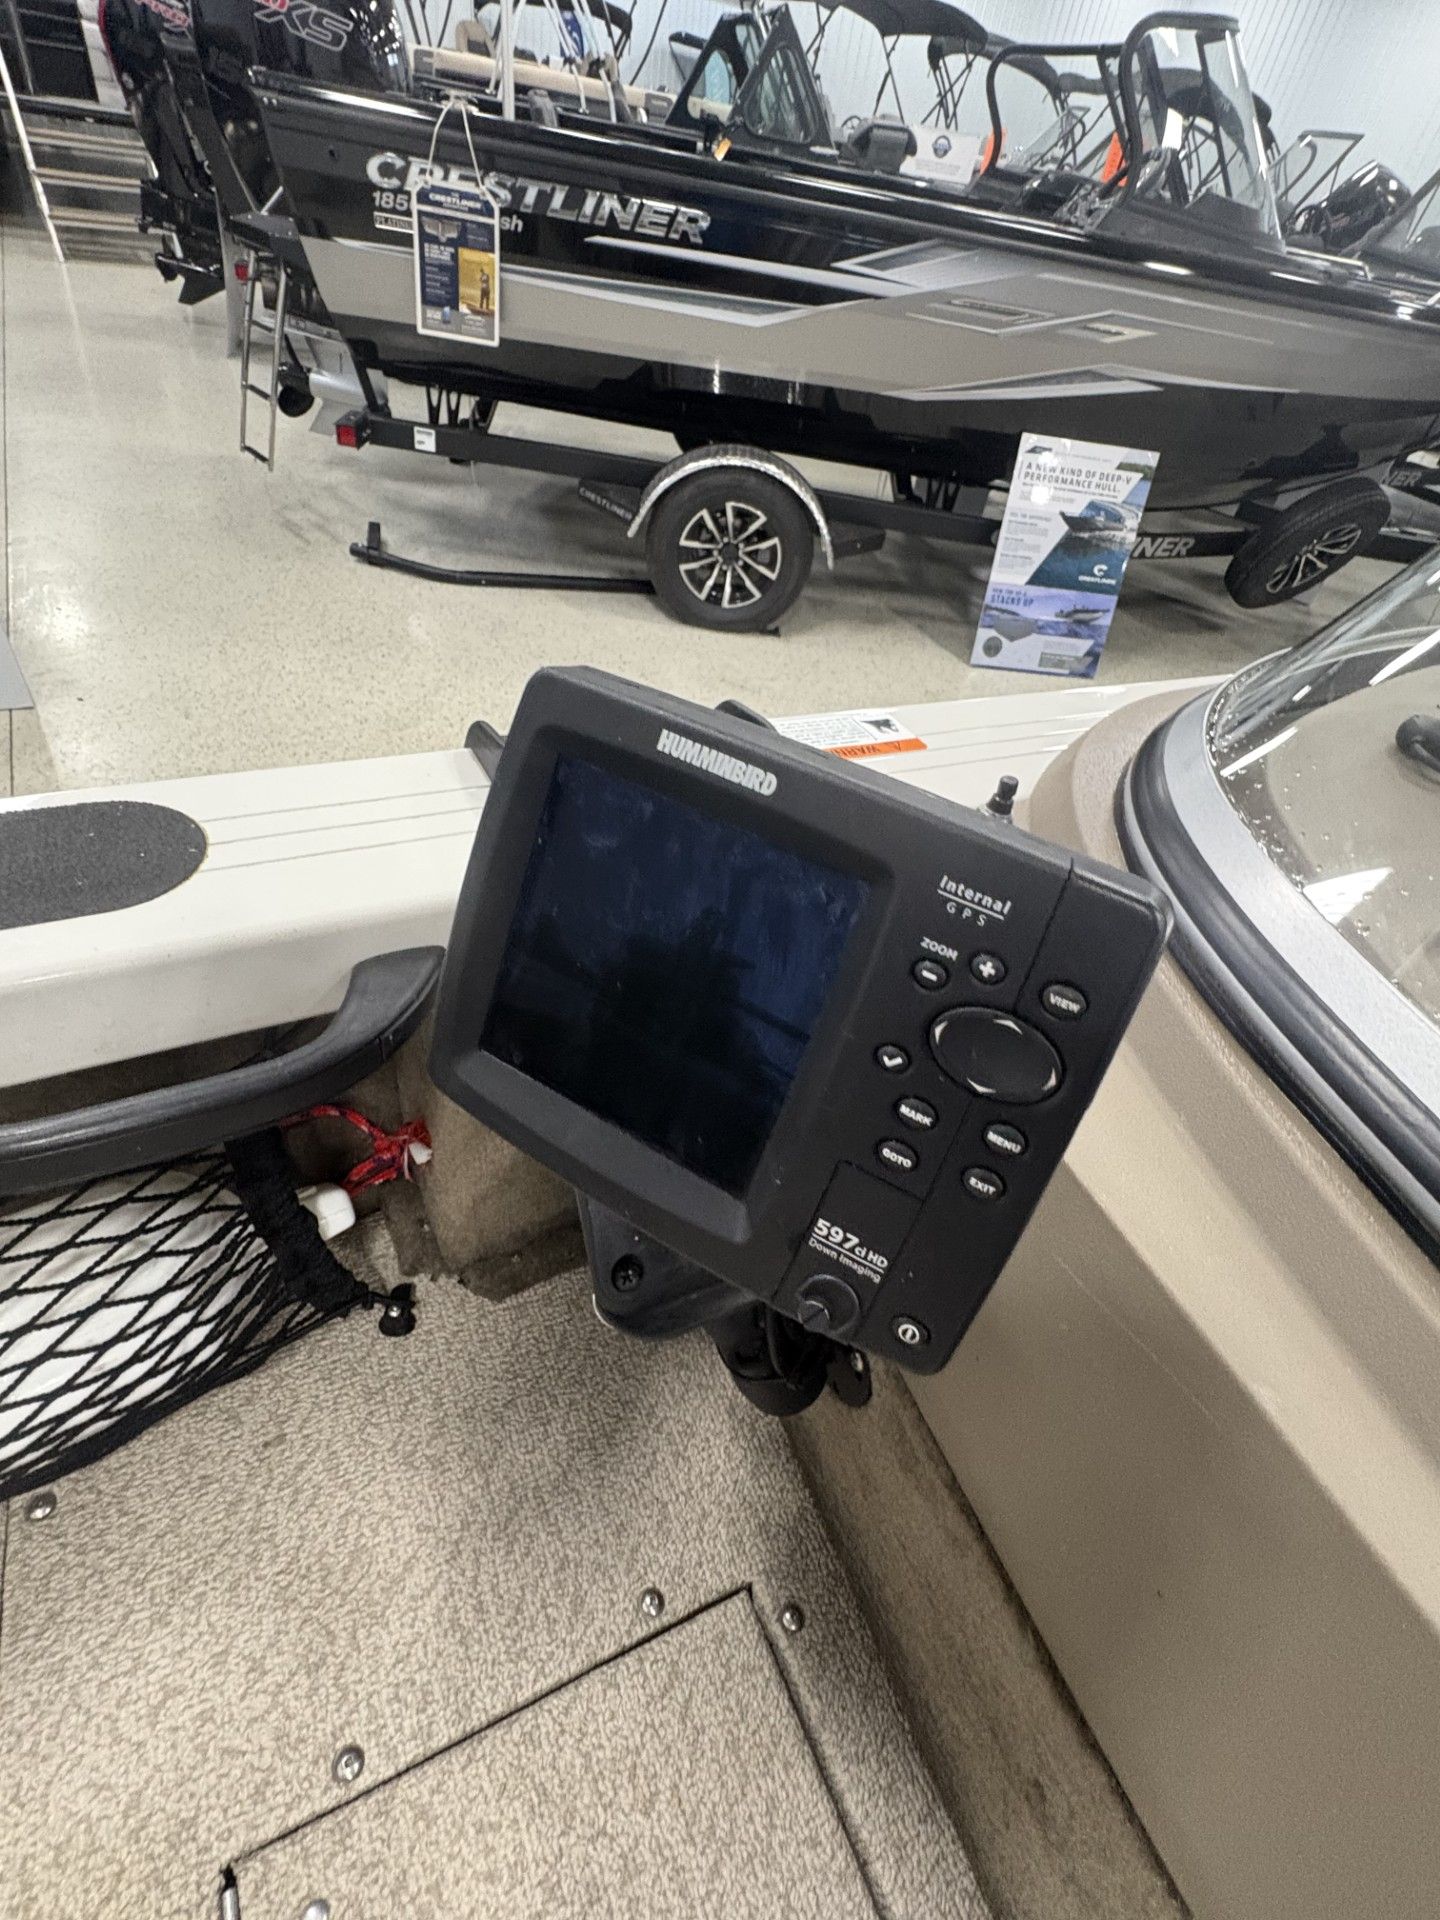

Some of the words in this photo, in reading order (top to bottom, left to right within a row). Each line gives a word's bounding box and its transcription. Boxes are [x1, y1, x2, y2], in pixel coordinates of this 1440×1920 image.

[365, 151, 711, 246] CRESTLINER
[372, 190, 412, 213] 185
[1024, 471, 1093, 489] PERFORMANCE
[1059, 465, 1082, 478] KIND
[1085, 468, 1097, 480] OF
[1132, 536, 1196, 558] NER
[656, 728, 779, 797] HUMMINBIRD
[938, 874, 1013, 916] Internal
[920, 936, 959, 962] ZOOM
[1049, 993, 1081, 1014] VIEW
[899, 1102, 933, 1127] MARK
[986, 1131, 1022, 1154] MENU
[881, 1147, 912, 1169] GOTO
[968, 1176, 997, 1196] EXIT
[808, 1238, 838, 1260] Down
[839, 1252, 883, 1284] Imaging
